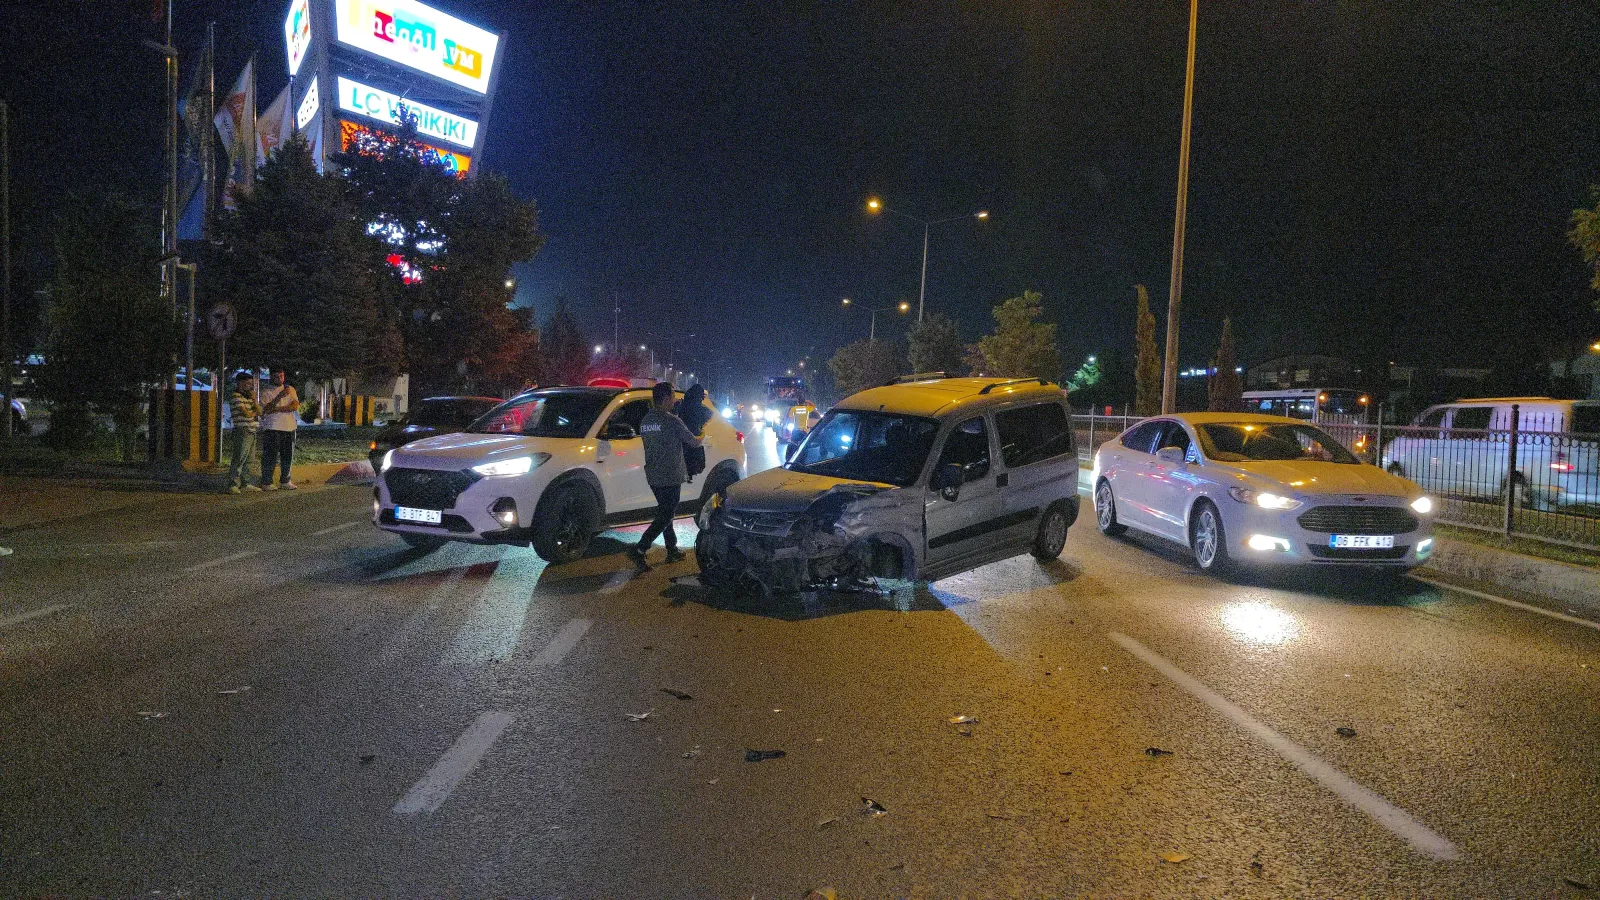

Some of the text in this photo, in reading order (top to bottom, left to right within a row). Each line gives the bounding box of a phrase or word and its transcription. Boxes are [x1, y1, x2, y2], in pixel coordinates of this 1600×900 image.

[352, 87, 381, 114] LC
[1337, 536, 1392, 546] 06 FFK 413
